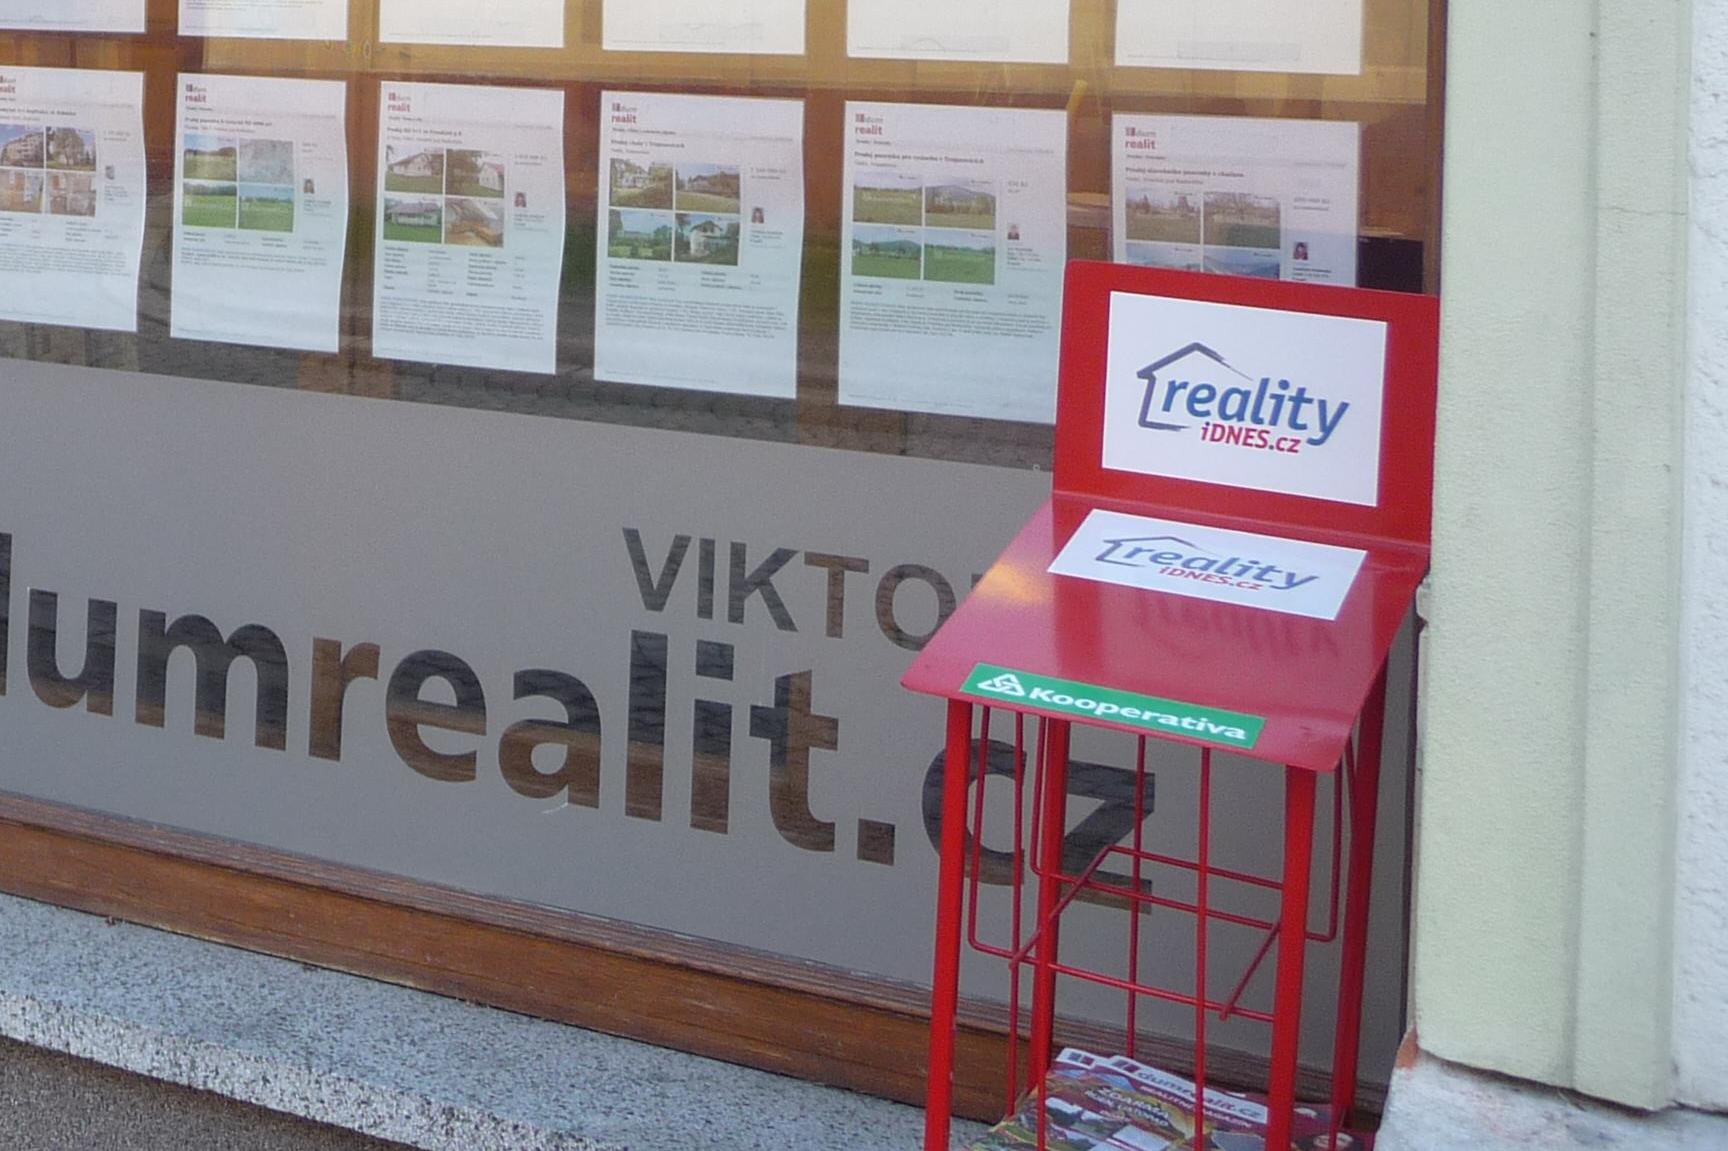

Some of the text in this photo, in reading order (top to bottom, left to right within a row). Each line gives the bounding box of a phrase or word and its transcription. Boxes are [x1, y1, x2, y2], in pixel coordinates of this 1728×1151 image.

[854, 122, 883, 136] realit
[1124, 135, 1157, 151] realit
[1161, 377, 1350, 447] reality
[1199, 421, 1302, 455] iDNES.cz
[1123, 541, 1320, 591] reality
[1157, 566, 1263, 591] iDNES.cz
[621, 526, 983, 651] VIKTO
[1027, 685, 1248, 742] Kooperativa
